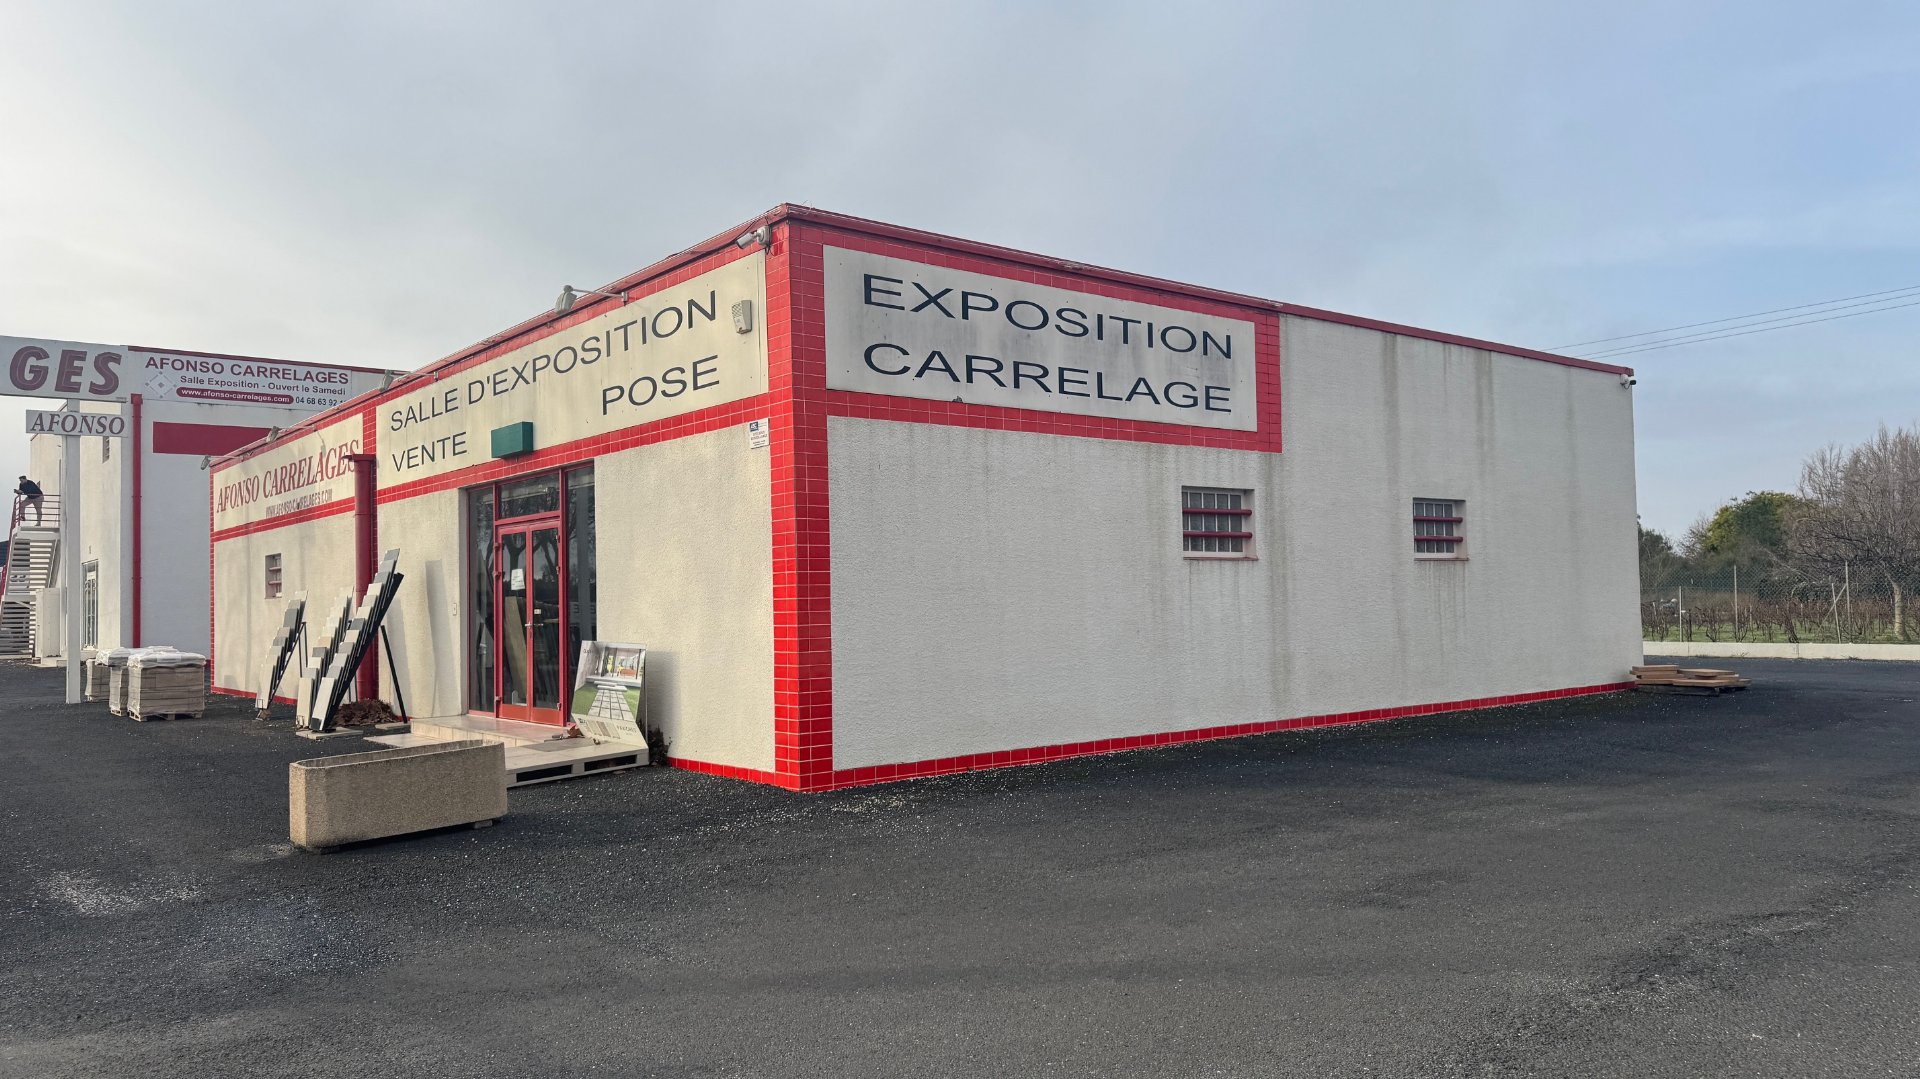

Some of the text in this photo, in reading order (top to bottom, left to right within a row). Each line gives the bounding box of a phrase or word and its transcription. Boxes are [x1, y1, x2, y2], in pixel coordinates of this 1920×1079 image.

[863, 273, 1232, 360] EXPOSITION
[9, 346, 122, 395] GES
[145, 356, 349, 384] AFONSO CARRELAGES
[180, 375, 204, 385] Salle
[207, 377, 259, 390] Exposition
[267, 382, 299, 392] Ouvert
[302, 384, 310, 393] le
[312, 385, 346, 395] Samedi
[390, 290, 718, 432] SALLE D'EXPOSITION
[863, 343, 1232, 413] CARRELAGE
[181, 388, 290, 403] www.afonso-carrelages.com
[295, 396, 305, 404] 04
[306, 397, 316, 405] 68
[317, 398, 327, 406] 63
[328, 399, 338, 407] 92
[391, 354, 720, 473] VENTE POSE
[30, 412, 125, 435] AFONSO
[216, 439, 360, 513] AFONSO CARRELAGES
